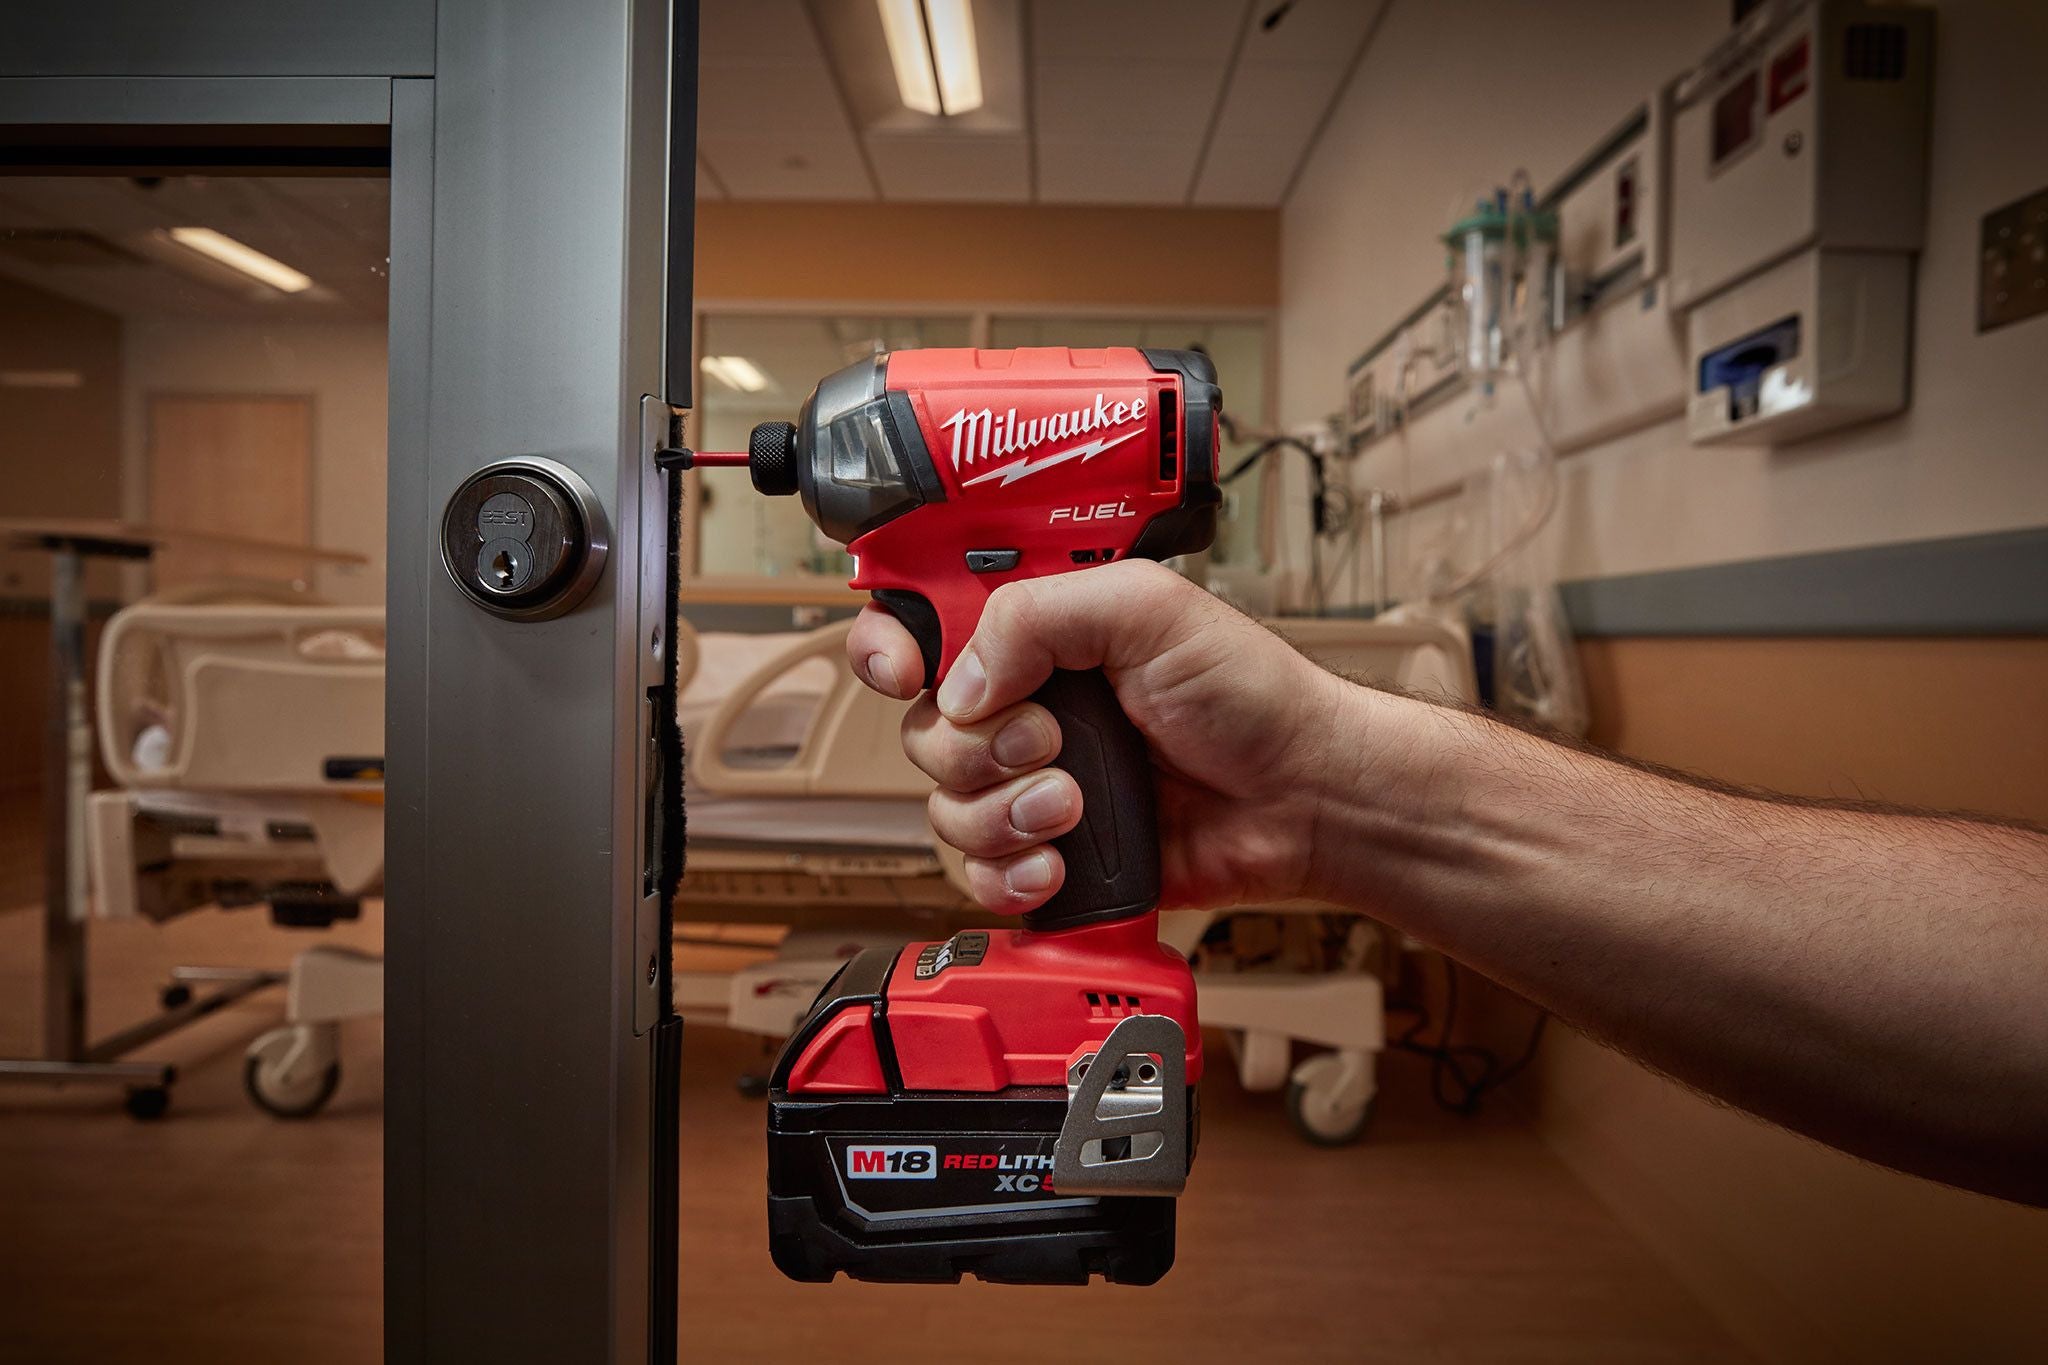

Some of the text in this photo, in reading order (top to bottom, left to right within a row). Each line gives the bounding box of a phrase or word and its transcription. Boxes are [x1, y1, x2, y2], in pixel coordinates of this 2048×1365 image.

[940, 393, 1147, 472] Milwaukee
[482, 510, 528, 526] BEST
[1049, 502, 1136, 524] FUEL
[853, 1151, 931, 1173] M18
